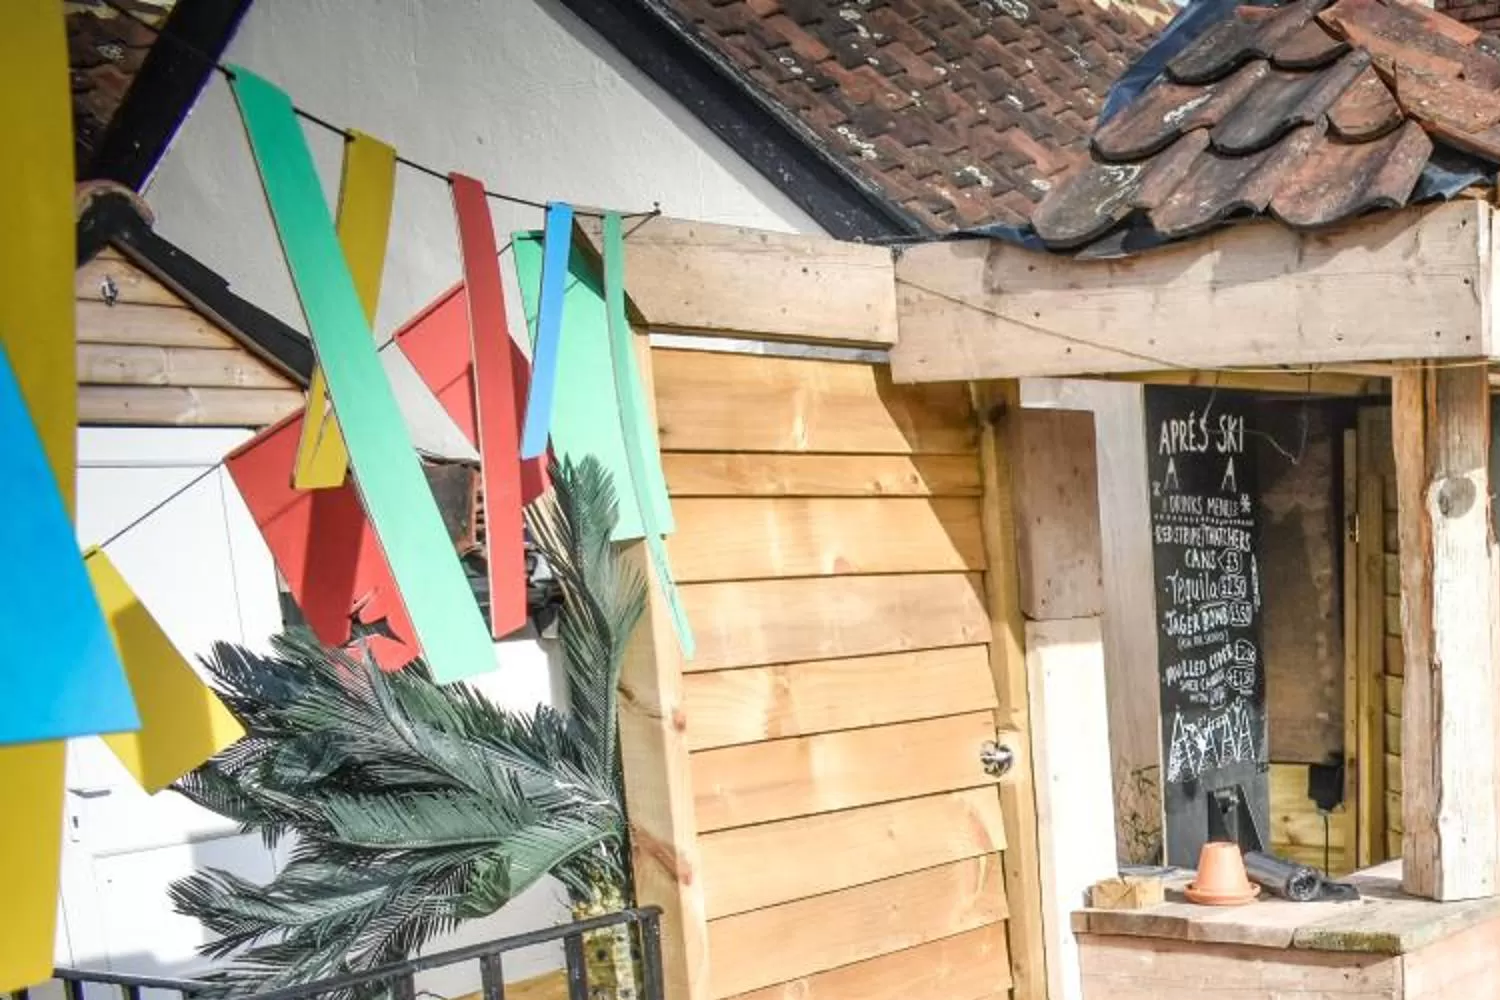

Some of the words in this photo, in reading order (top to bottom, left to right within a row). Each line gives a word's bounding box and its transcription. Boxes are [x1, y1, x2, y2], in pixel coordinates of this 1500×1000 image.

[1216, 414, 1244, 453] SKI
[1185, 548, 1217, 570] CANS
[1165, 568, 1219, 606] Tequila
